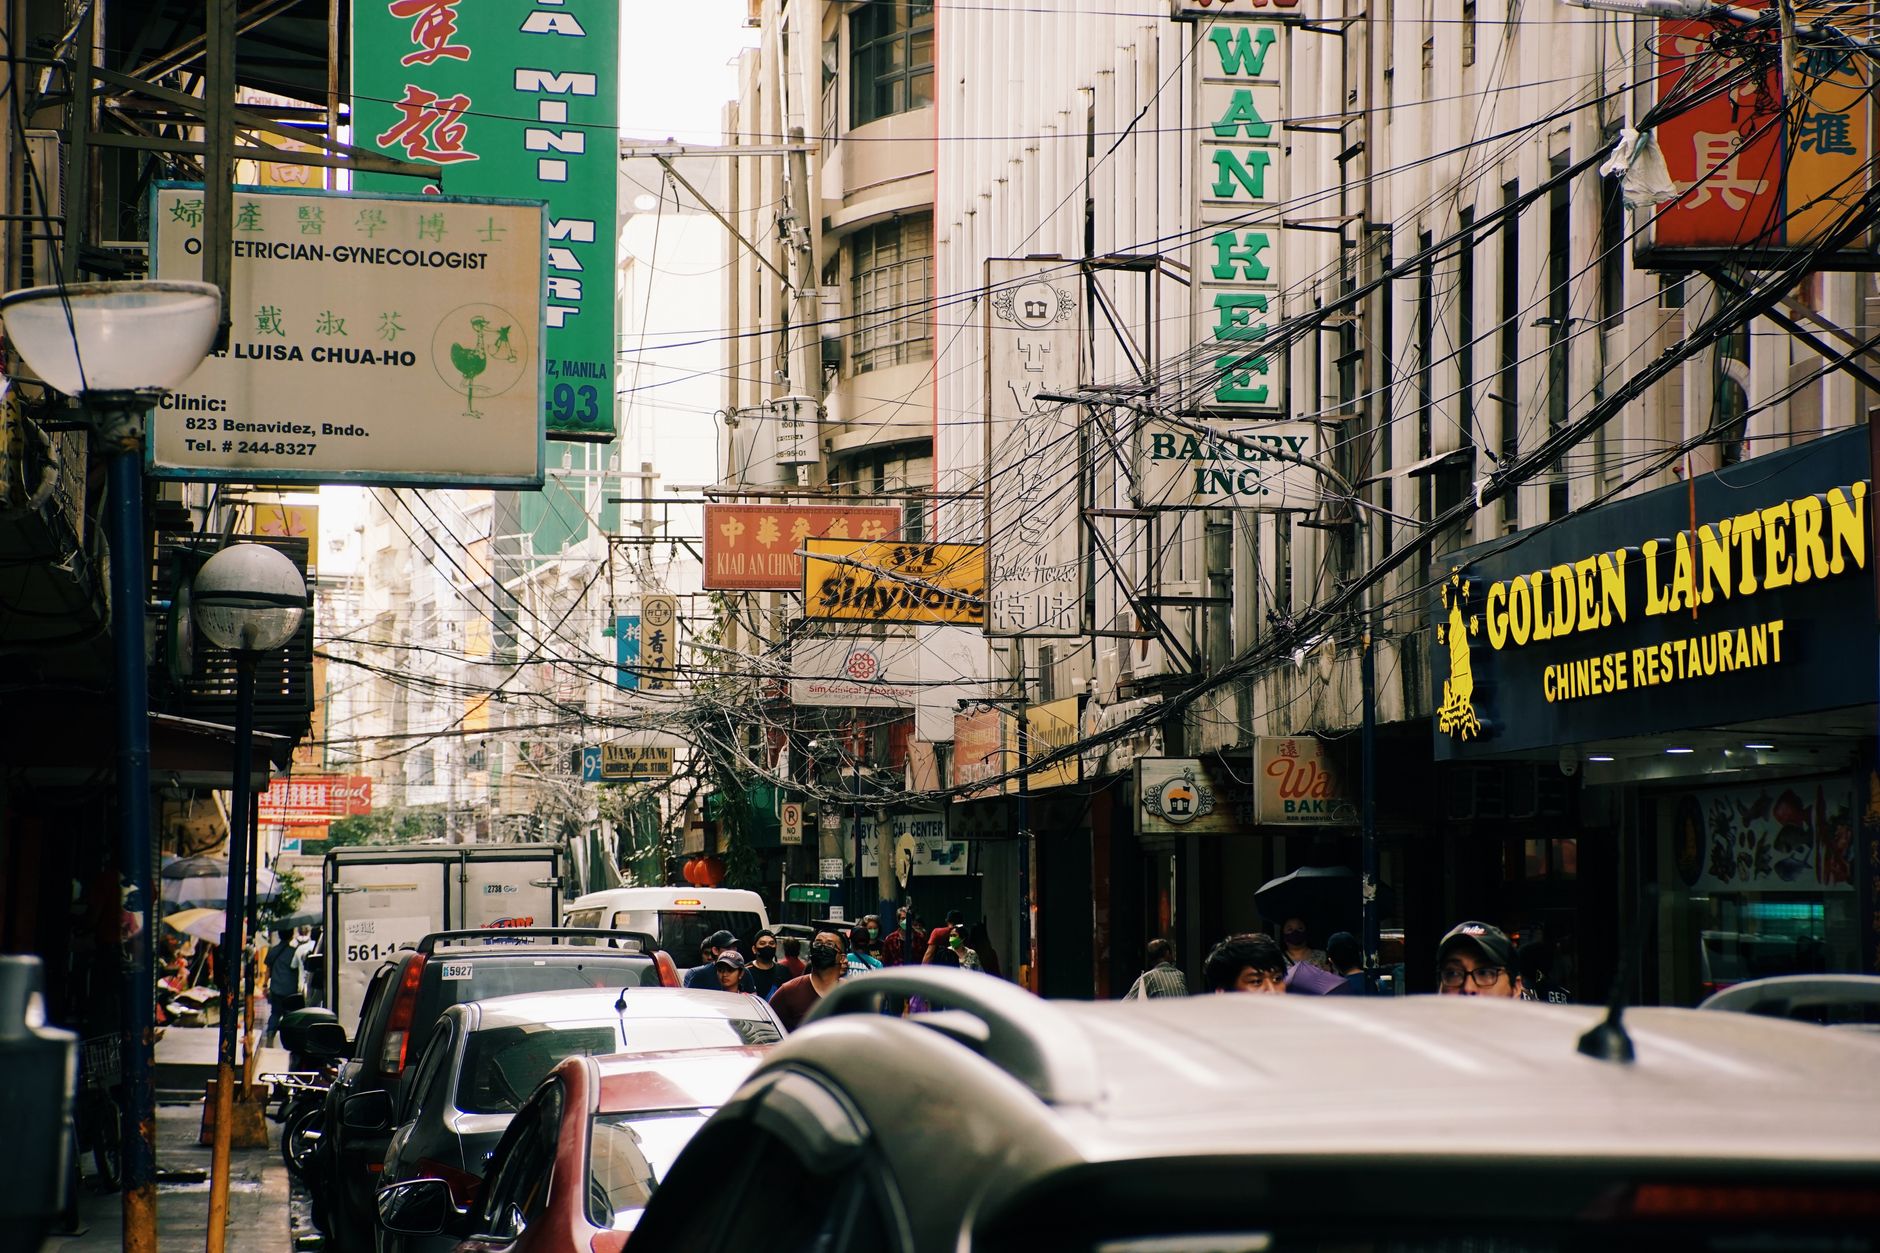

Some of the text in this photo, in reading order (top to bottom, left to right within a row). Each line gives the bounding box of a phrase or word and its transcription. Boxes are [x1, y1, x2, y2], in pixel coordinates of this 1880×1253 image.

[514, 67, 597, 183] MINI
[184, 238, 488, 269] OETRICIAN-GYNECOLOGIST
[234, 343, 304, 361] LUISA
[311, 347, 416, 366] CHUA-HO
[562, 360, 608, 379] MANILA
[159, 394, 227, 412] Clinic:
[185, 417, 370, 437] 823 Benavidez, Bndo.
[185, 438, 317, 456] Tel. # 244-8327
[1150, 433, 1309, 462] BAKERY
[1193, 468, 1269, 496] INC.
[717, 552, 745, 575] KIAO
[750, 552, 765, 575] AN
[1486, 481, 1867, 650] GOLDEN LANTERN
[1544, 620, 1784, 703] CHINESE RESTAURANT
[808, 685, 827, 693] Sim
[864, 686, 914, 697] Laboratory
[786, 827, 796, 835] NO
[910, 820, 944, 837] CENTER
[449, 966, 473, 977] 5927
